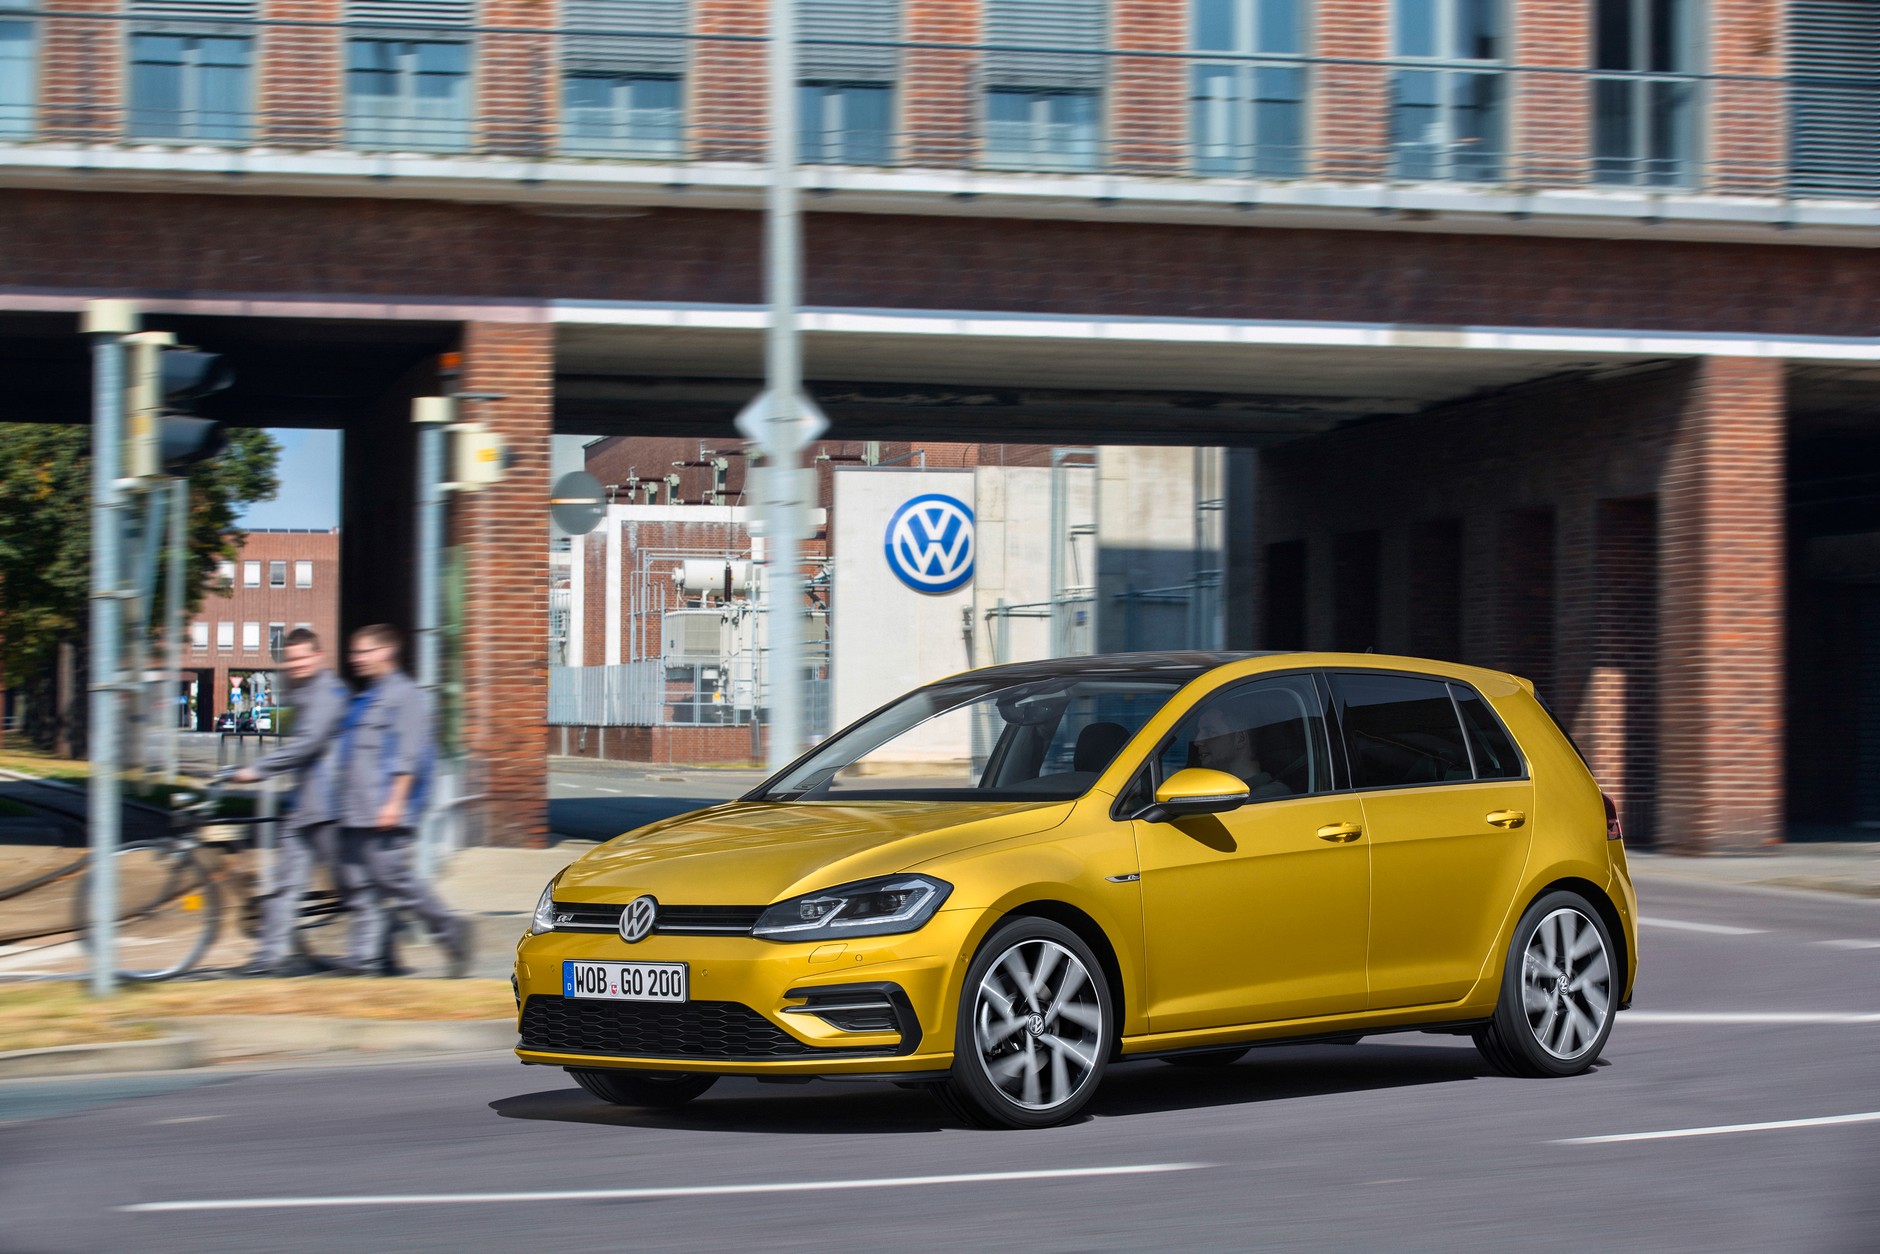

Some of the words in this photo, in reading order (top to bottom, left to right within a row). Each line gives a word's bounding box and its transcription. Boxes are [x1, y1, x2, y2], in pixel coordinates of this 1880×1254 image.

[892, 500, 975, 583] VW
[620, 897, 656, 940] VW
[567, 982, 572, 991] D
[575, 966, 607, 994] WOB
[621, 968, 643, 995] GO
[648, 969, 682, 997] 200
